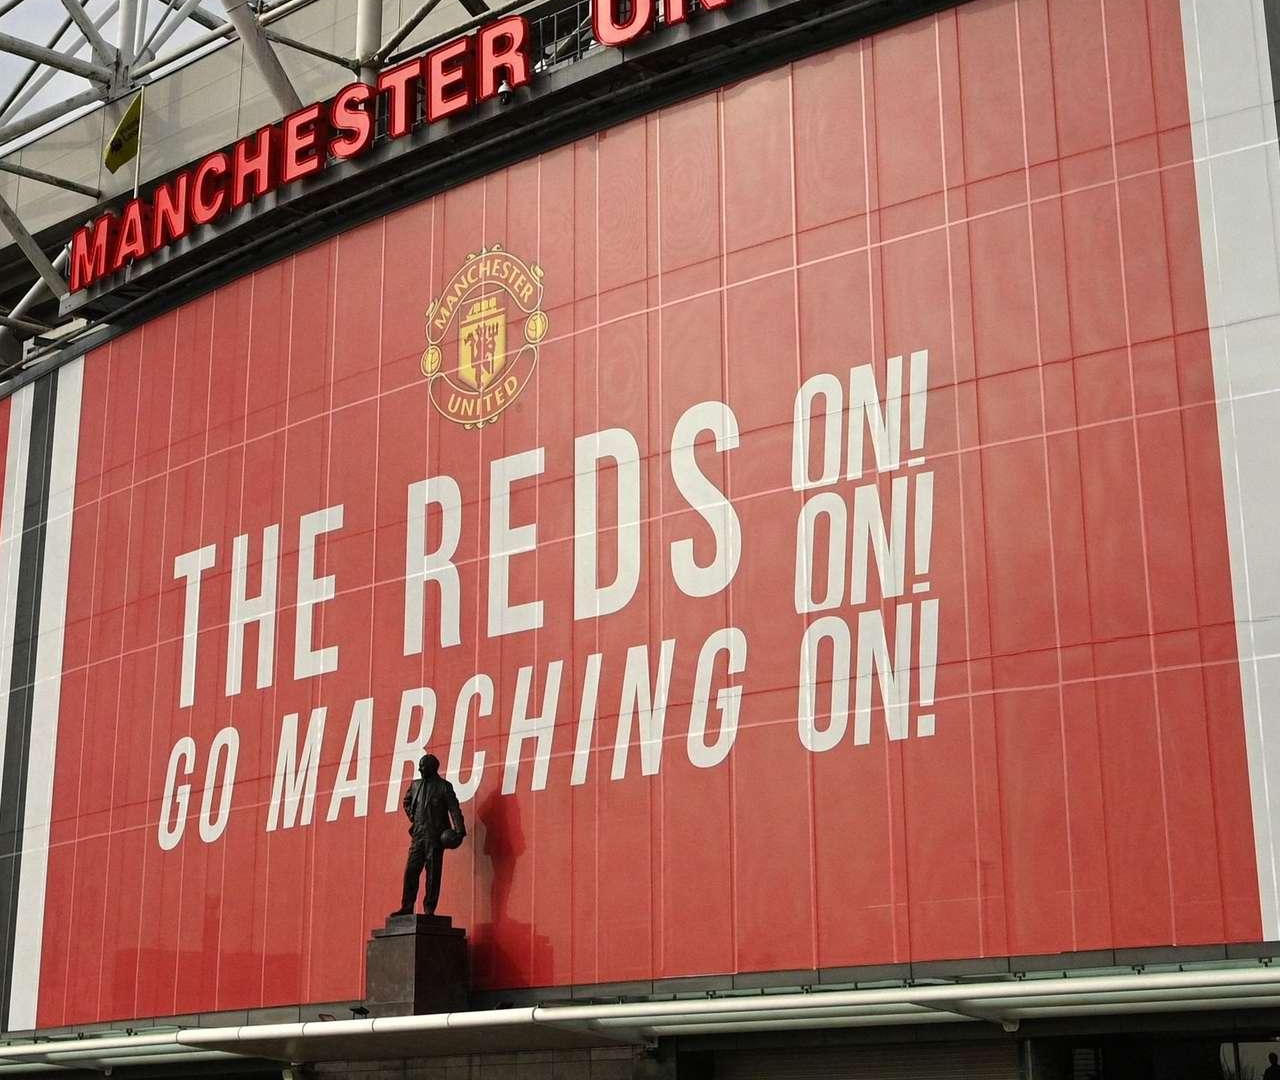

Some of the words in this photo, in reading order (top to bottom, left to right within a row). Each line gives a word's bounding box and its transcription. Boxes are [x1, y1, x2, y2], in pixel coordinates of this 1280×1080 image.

[70, 14, 530, 294] MANCHESTER
[434, 258, 534, 330] MANCHESTER
[447, 375, 518, 416] UNITED
[792, 349, 930, 492] ON!
[174, 504, 344, 708] THE
[403, 401, 742, 656] REDS
[794, 472, 935, 614] ON!
[158, 727, 240, 851] GO
[266, 627, 748, 832] MARCHING
[798, 600, 940, 753] ON!
